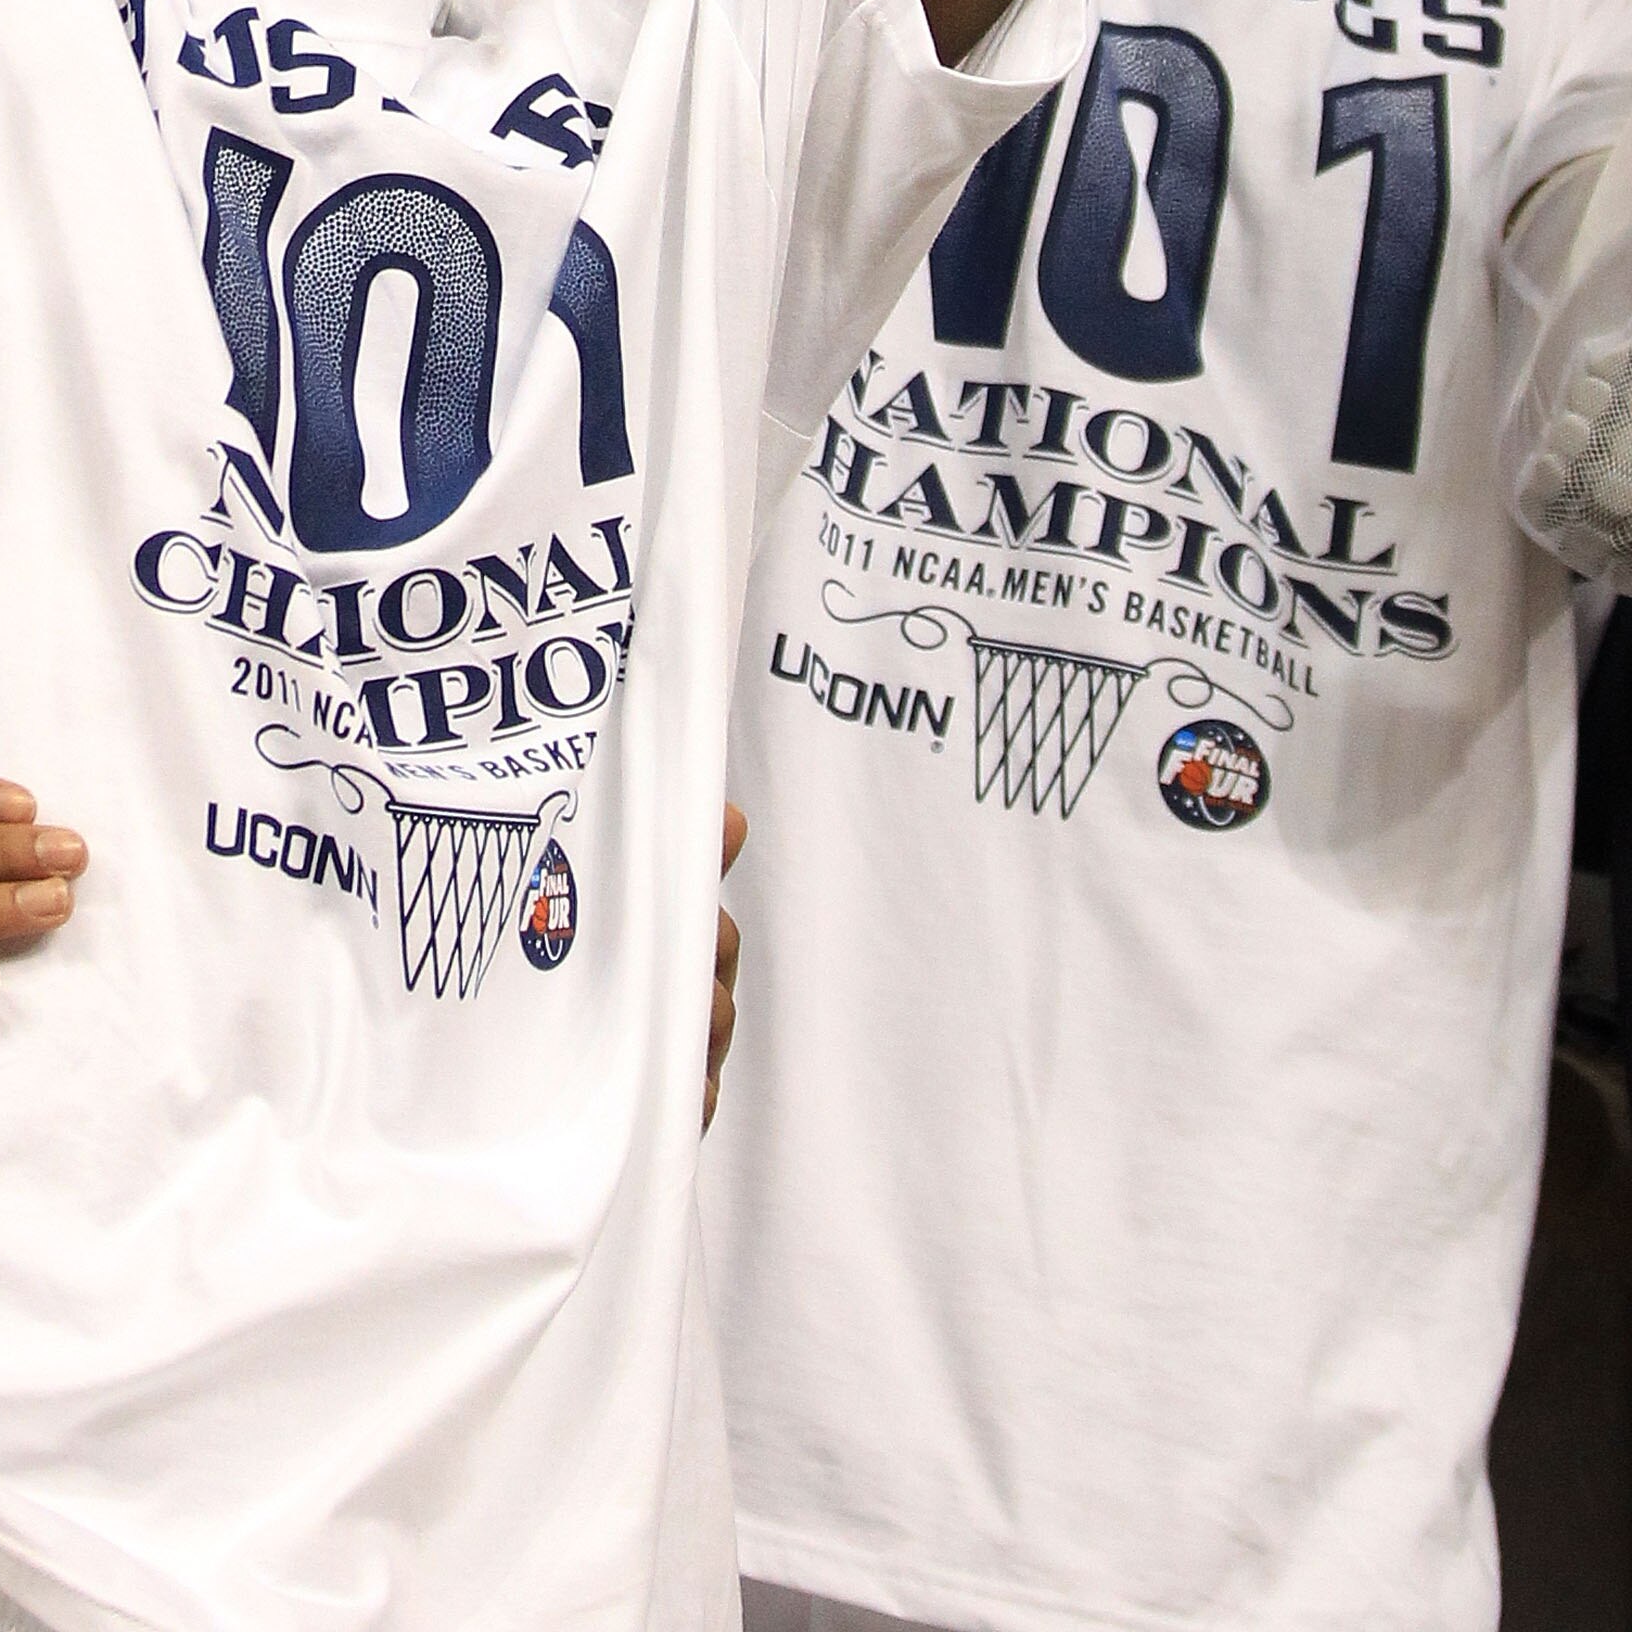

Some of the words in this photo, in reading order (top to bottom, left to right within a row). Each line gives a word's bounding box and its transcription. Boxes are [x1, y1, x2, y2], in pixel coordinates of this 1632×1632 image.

[818, 512, 874, 572] 2011
[998, 566, 1110, 615] MEN'S
[1123, 590, 1320, 698] BASKETBALL
[231, 656, 302, 712] 2011
[768, 632, 956, 736] UCONN
[1193, 739, 1261, 778] FINAL
[206, 801, 379, 914] UCONN
[539, 867, 570, 897] FINAL
